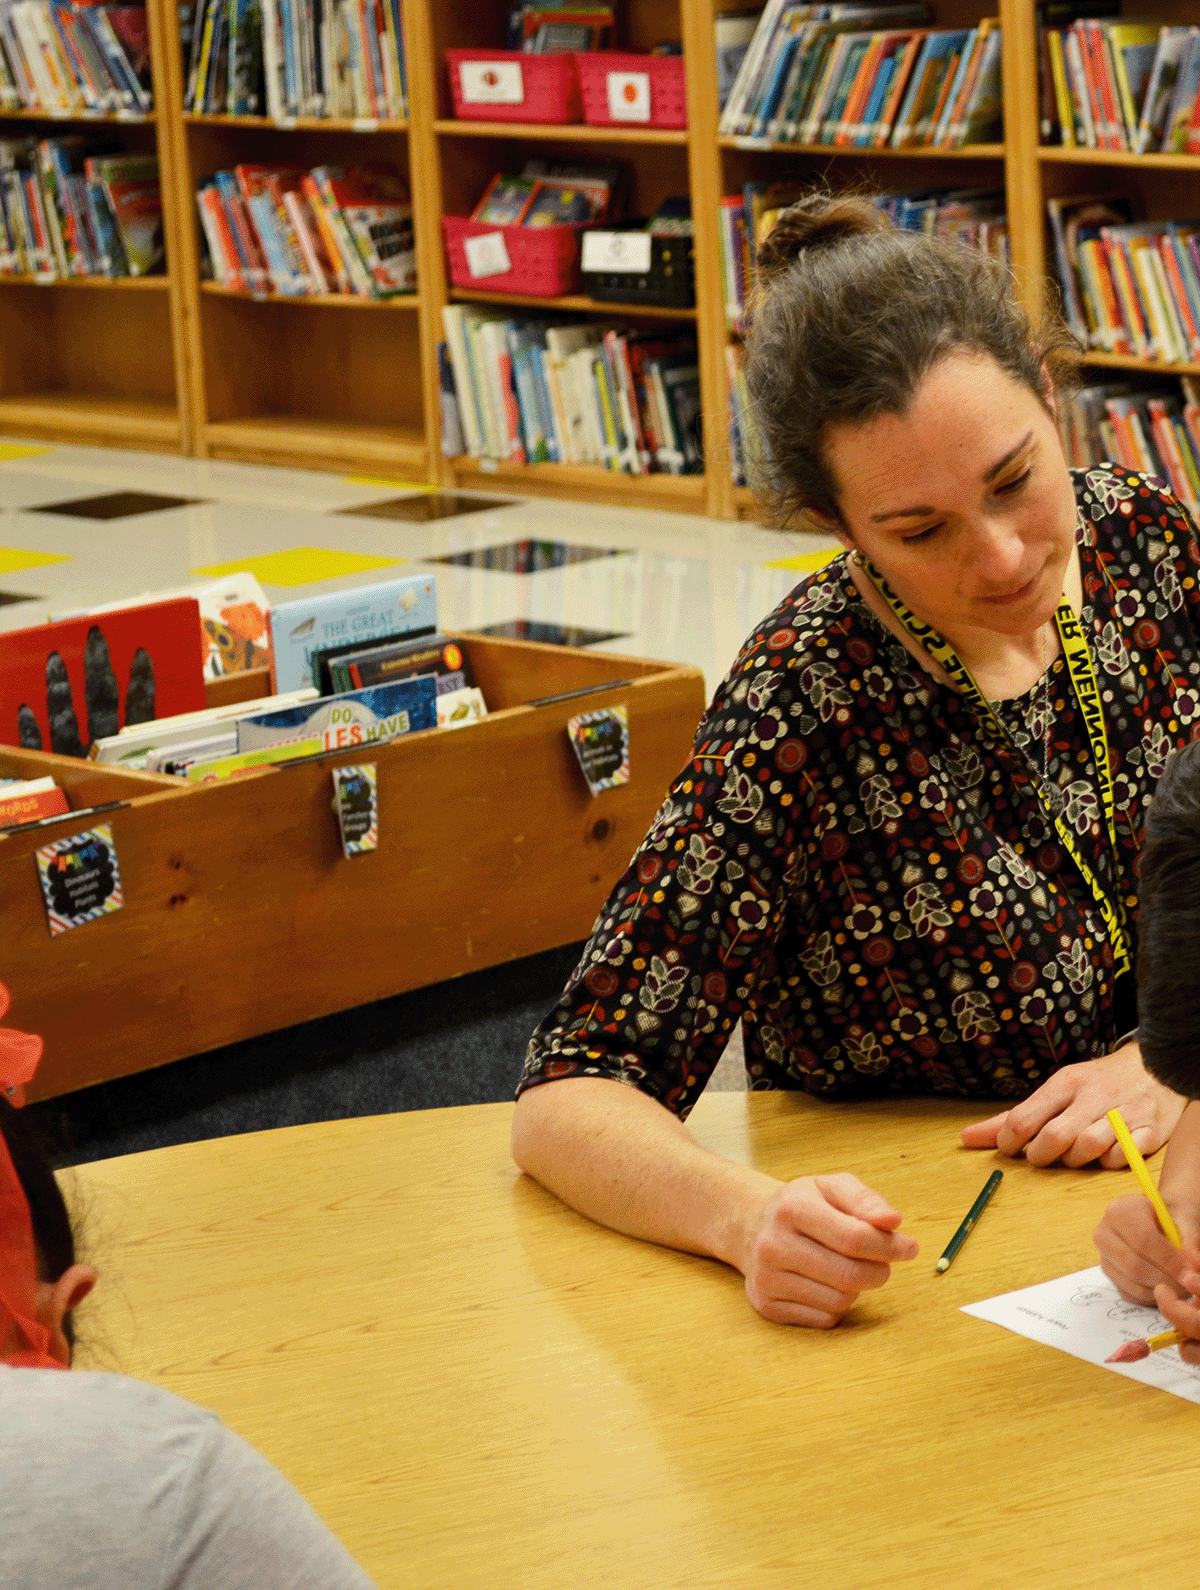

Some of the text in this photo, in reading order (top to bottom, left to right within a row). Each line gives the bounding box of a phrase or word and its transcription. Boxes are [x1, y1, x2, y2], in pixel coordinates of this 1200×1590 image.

[321, 619, 348, 638] THE
[351, 609, 395, 632] GREAT
[331, 707, 352, 724] DO
[366, 713, 408, 741] HAVE
[1055, 817, 1131, 980] LANCASTER
